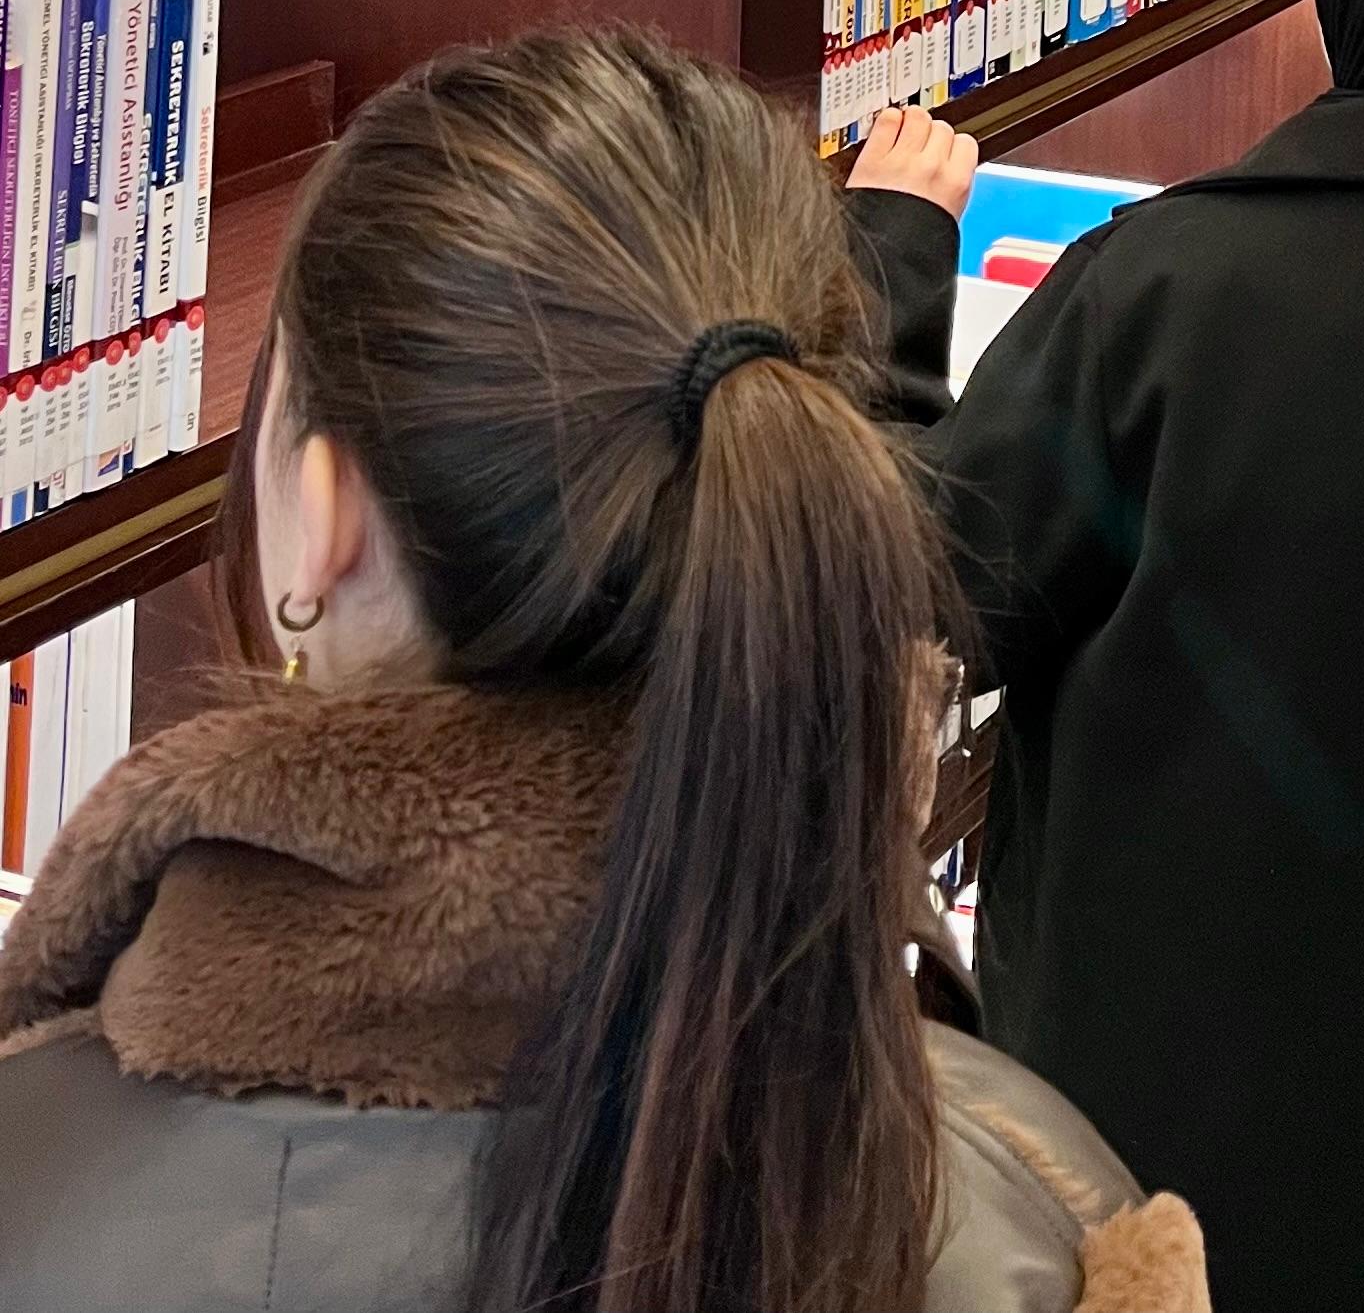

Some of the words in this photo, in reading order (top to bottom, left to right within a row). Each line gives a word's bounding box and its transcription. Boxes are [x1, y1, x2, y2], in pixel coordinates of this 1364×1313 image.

[38, 29, 51, 79] YÖNETİCİ
[75, 21, 93, 111] Sekreterlik
[94, 34, 107, 71] Yönetici
[122, 2, 142, 90] Yönetici
[89, 74, 105, 128] Asistanlığı
[163, 40, 185, 186] SEKRETERLİK
[72, 114, 89, 164] Bilgisi
[92, 130, 101, 141] ve
[113, 99, 138, 211] Asistanlığı
[197, 106, 212, 190] Sekreterlik
[88, 142, 101, 197] Sekreterlik
[162, 192, 175, 217] EL
[193, 195, 207, 244] Bilgisi
[30, 236, 40, 248] EL
[51, 190, 68, 289] SEKRETERLİK
[158, 224, 176, 293] KİTABI
[48, 293, 63, 347] BİLGİSİ
